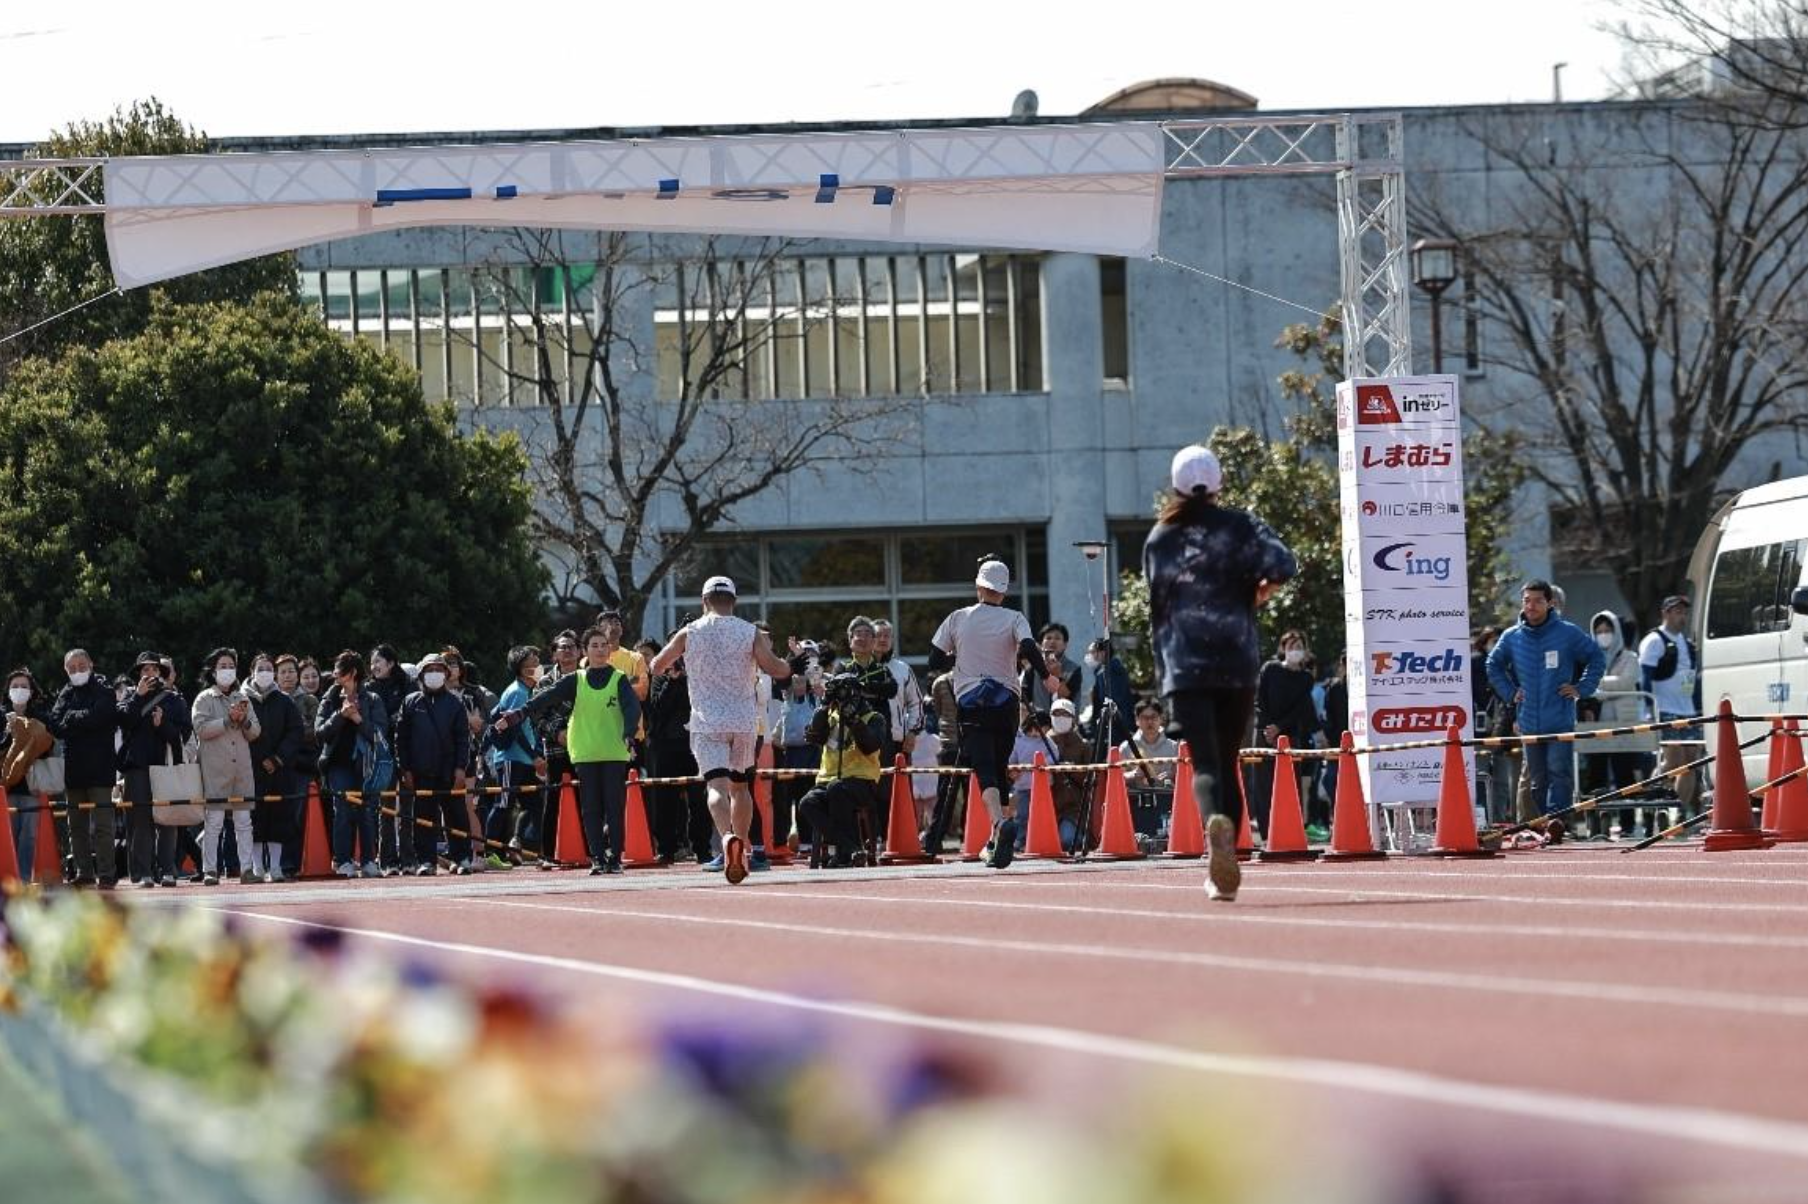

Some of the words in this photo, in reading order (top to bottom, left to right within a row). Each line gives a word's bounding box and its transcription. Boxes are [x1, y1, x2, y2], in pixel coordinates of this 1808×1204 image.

[1362, 443, 1453, 468] しまむら
[1366, 609, 1398, 620] STK
[1398, 609, 1427, 621] photo
[1429, 609, 1465, 619] service
